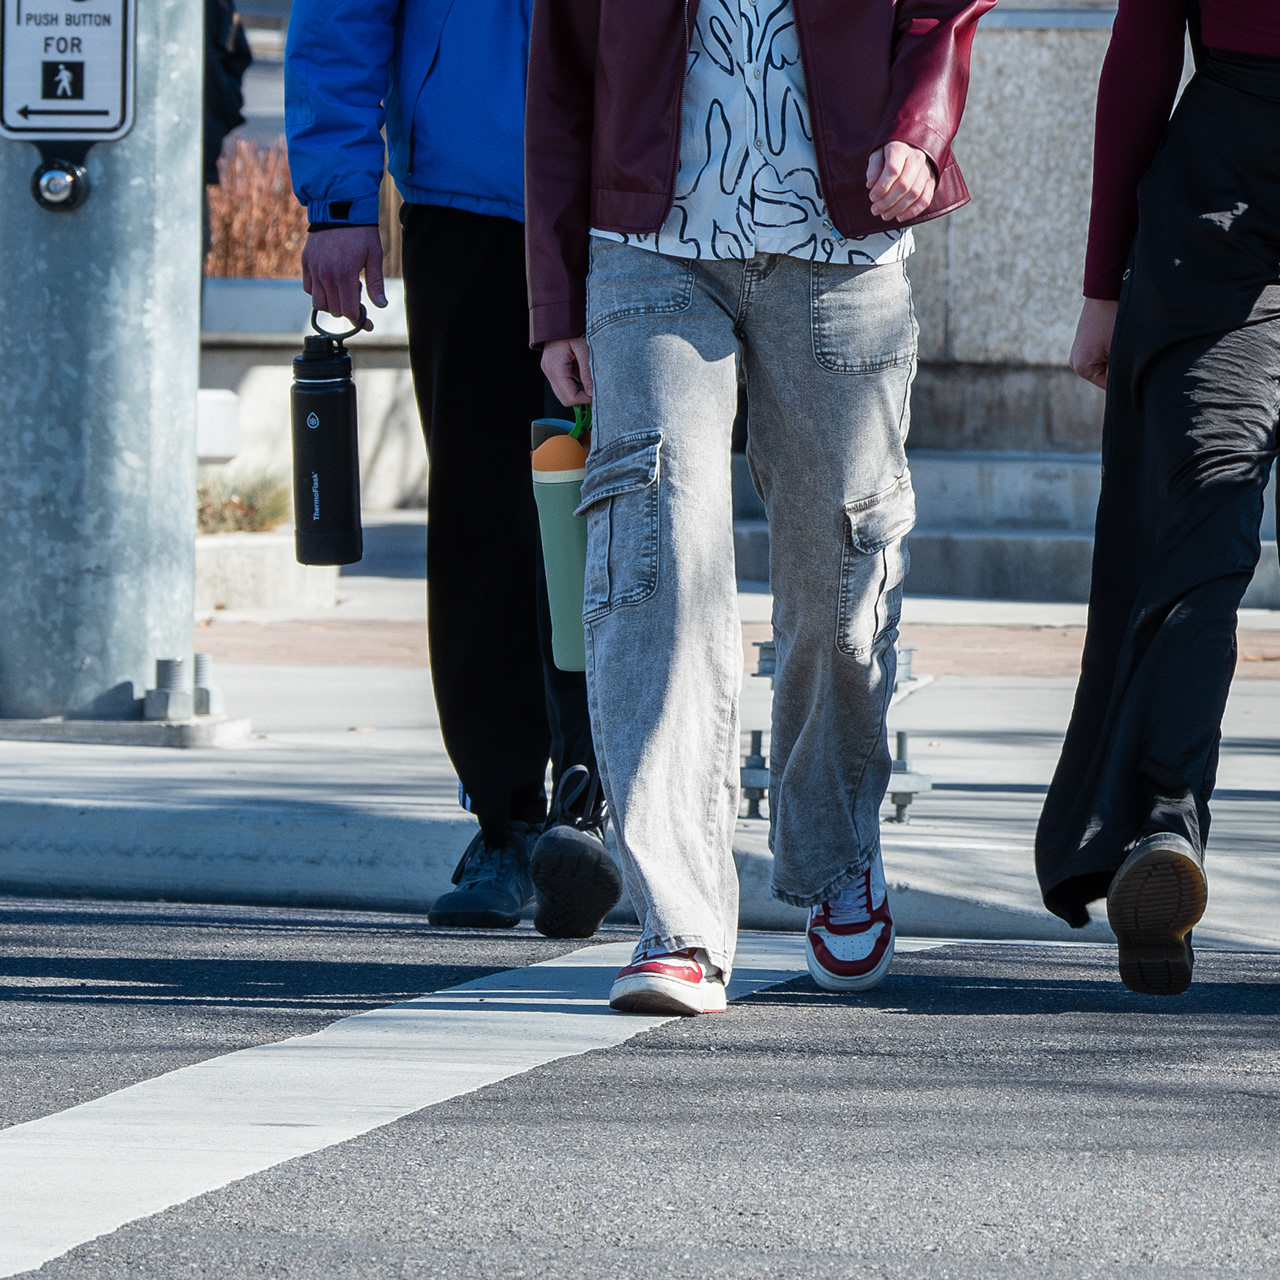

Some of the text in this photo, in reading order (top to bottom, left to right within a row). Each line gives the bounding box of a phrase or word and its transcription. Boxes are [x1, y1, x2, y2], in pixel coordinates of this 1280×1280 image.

[25, 13, 112, 26] PUSH BUTTON
[44, 36, 82, 54] FOR
